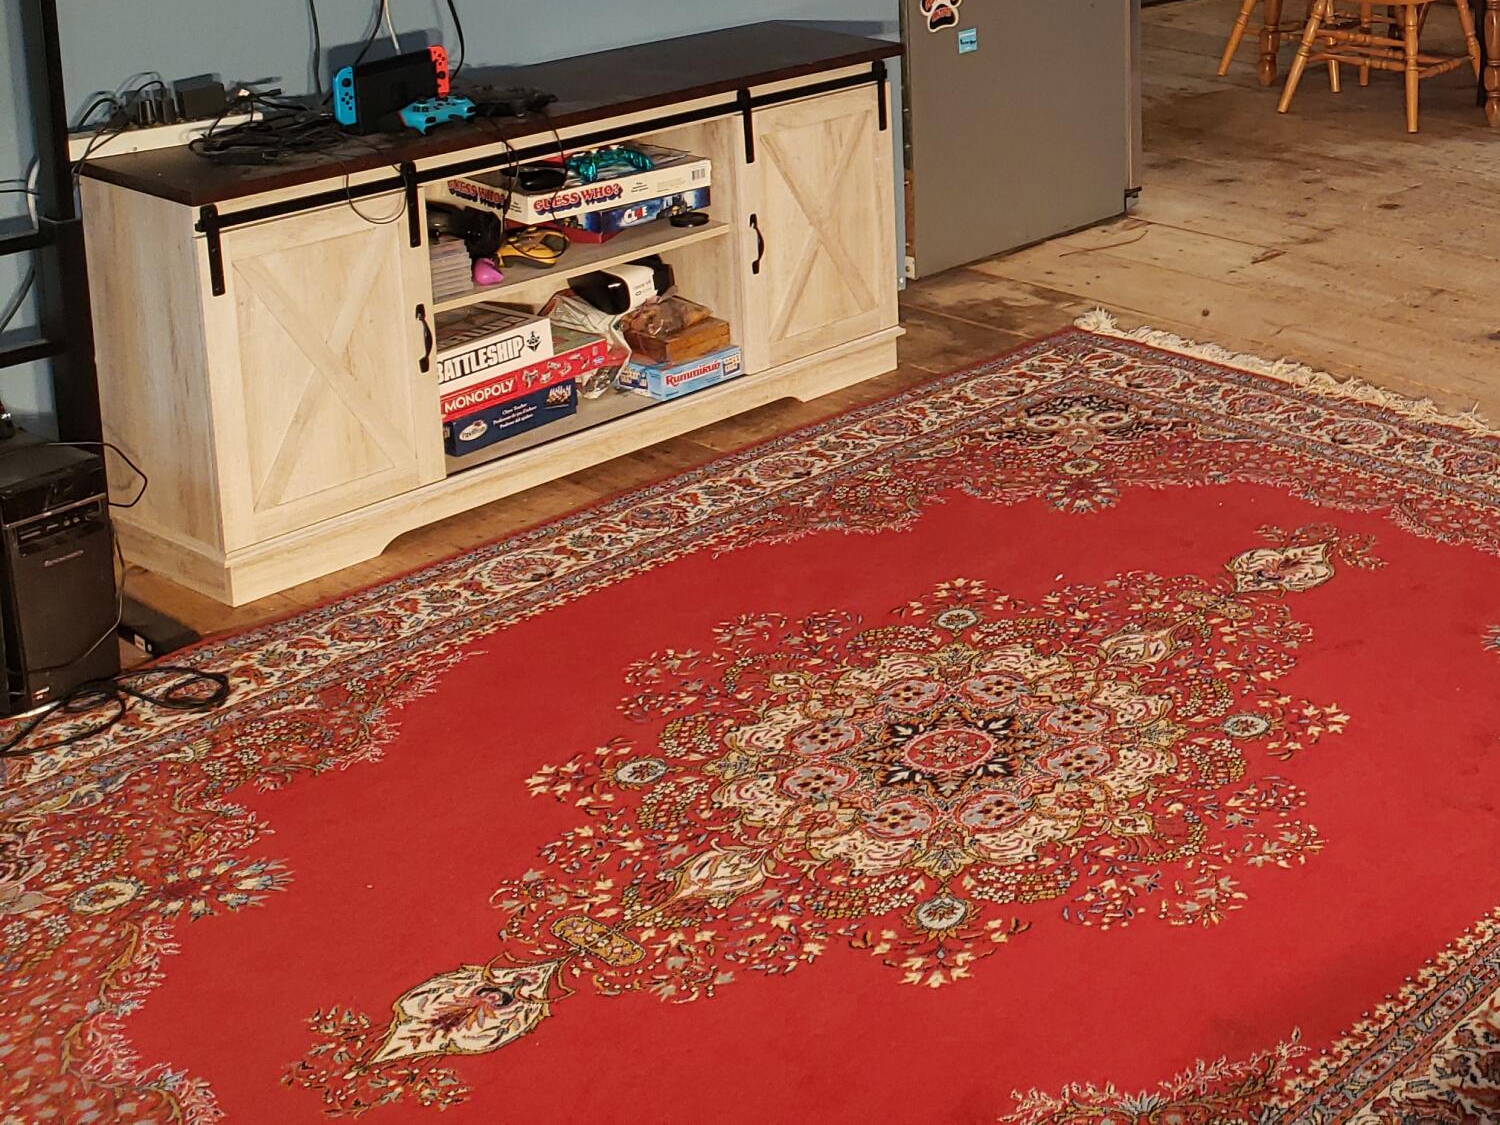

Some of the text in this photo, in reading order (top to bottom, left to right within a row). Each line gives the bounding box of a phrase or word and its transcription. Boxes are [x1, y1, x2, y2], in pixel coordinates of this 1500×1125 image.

[477, 186, 506, 205] WHO?
[533, 191, 582, 214] GUESS
[582, 182, 625, 205] WHO?
[623, 206, 648, 224] CLUE
[436, 334, 525, 385] BATTLESHIP
[665, 360, 720, 387] Rummikub
[444, 378, 515, 413] MONOPOLY
